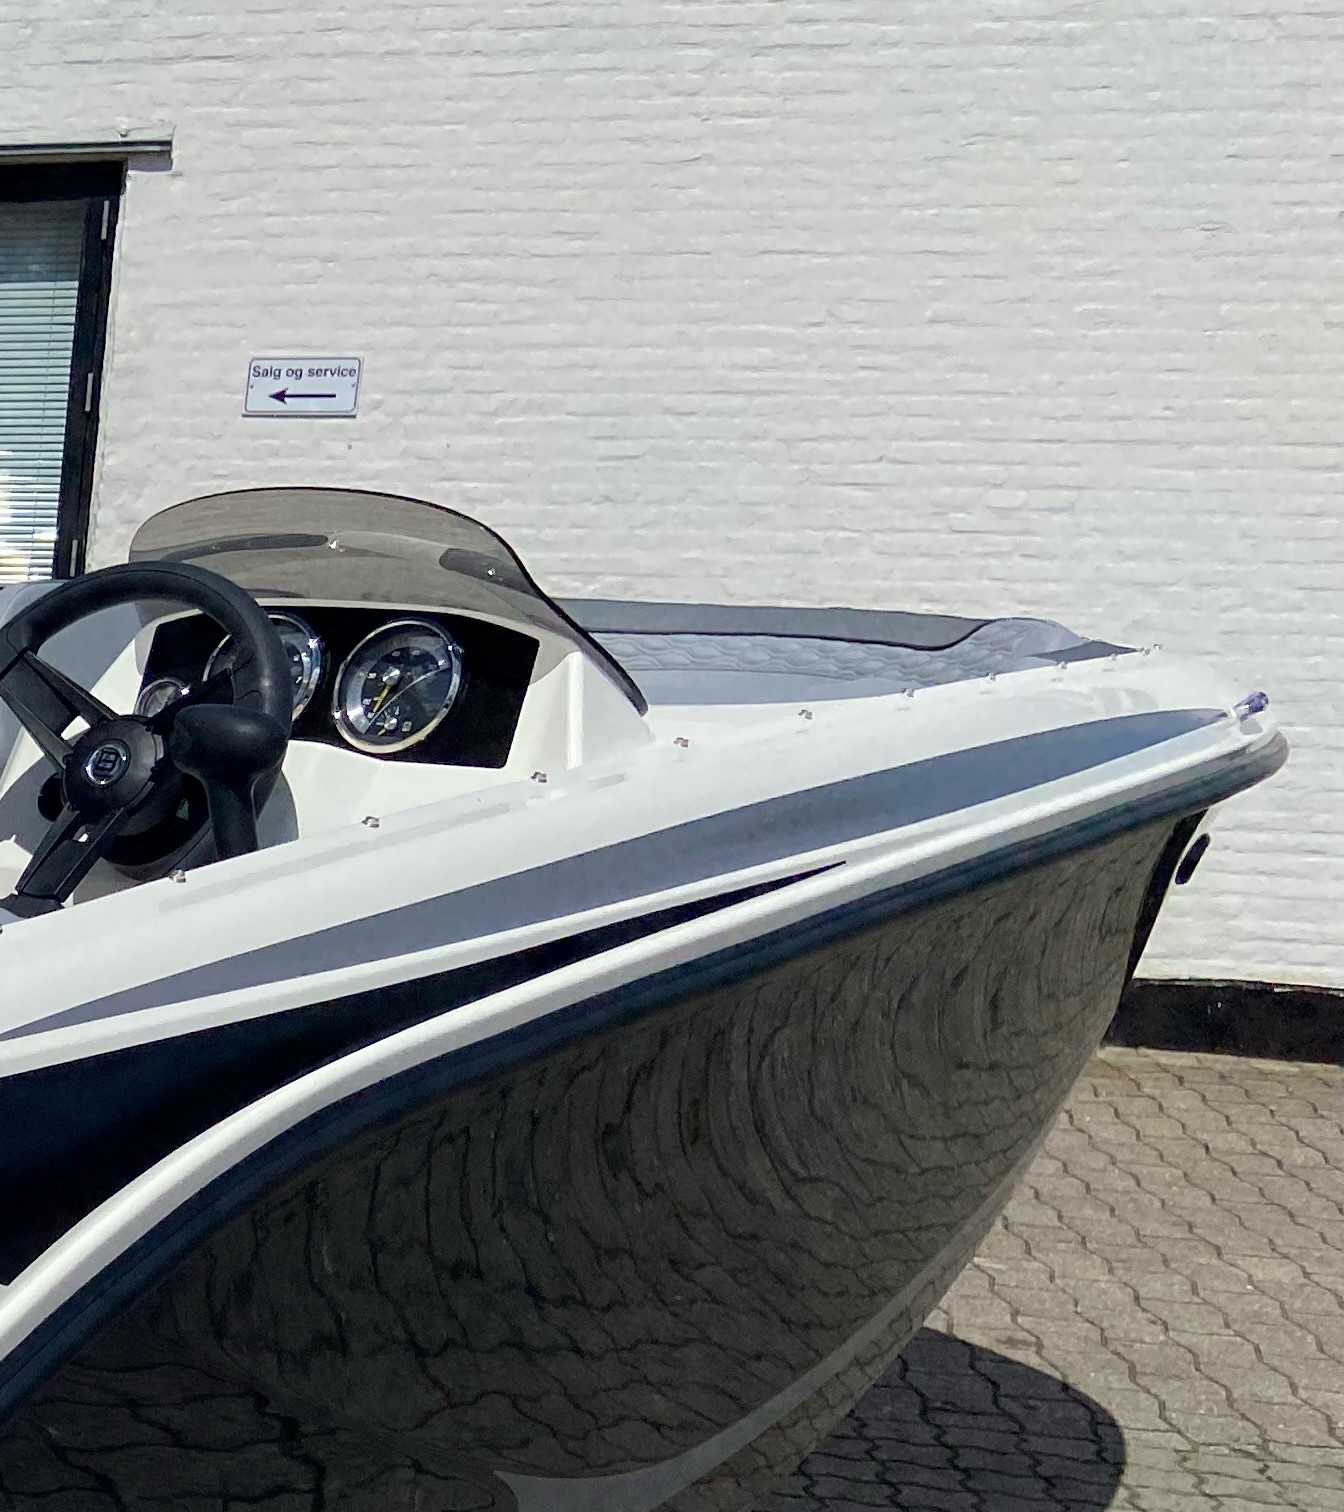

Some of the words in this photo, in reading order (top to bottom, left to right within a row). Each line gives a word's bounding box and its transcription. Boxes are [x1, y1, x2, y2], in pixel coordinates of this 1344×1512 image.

[252, 365, 281, 380] Salg
[286, 368, 303, 380] og
[308, 365, 357, 377] service
